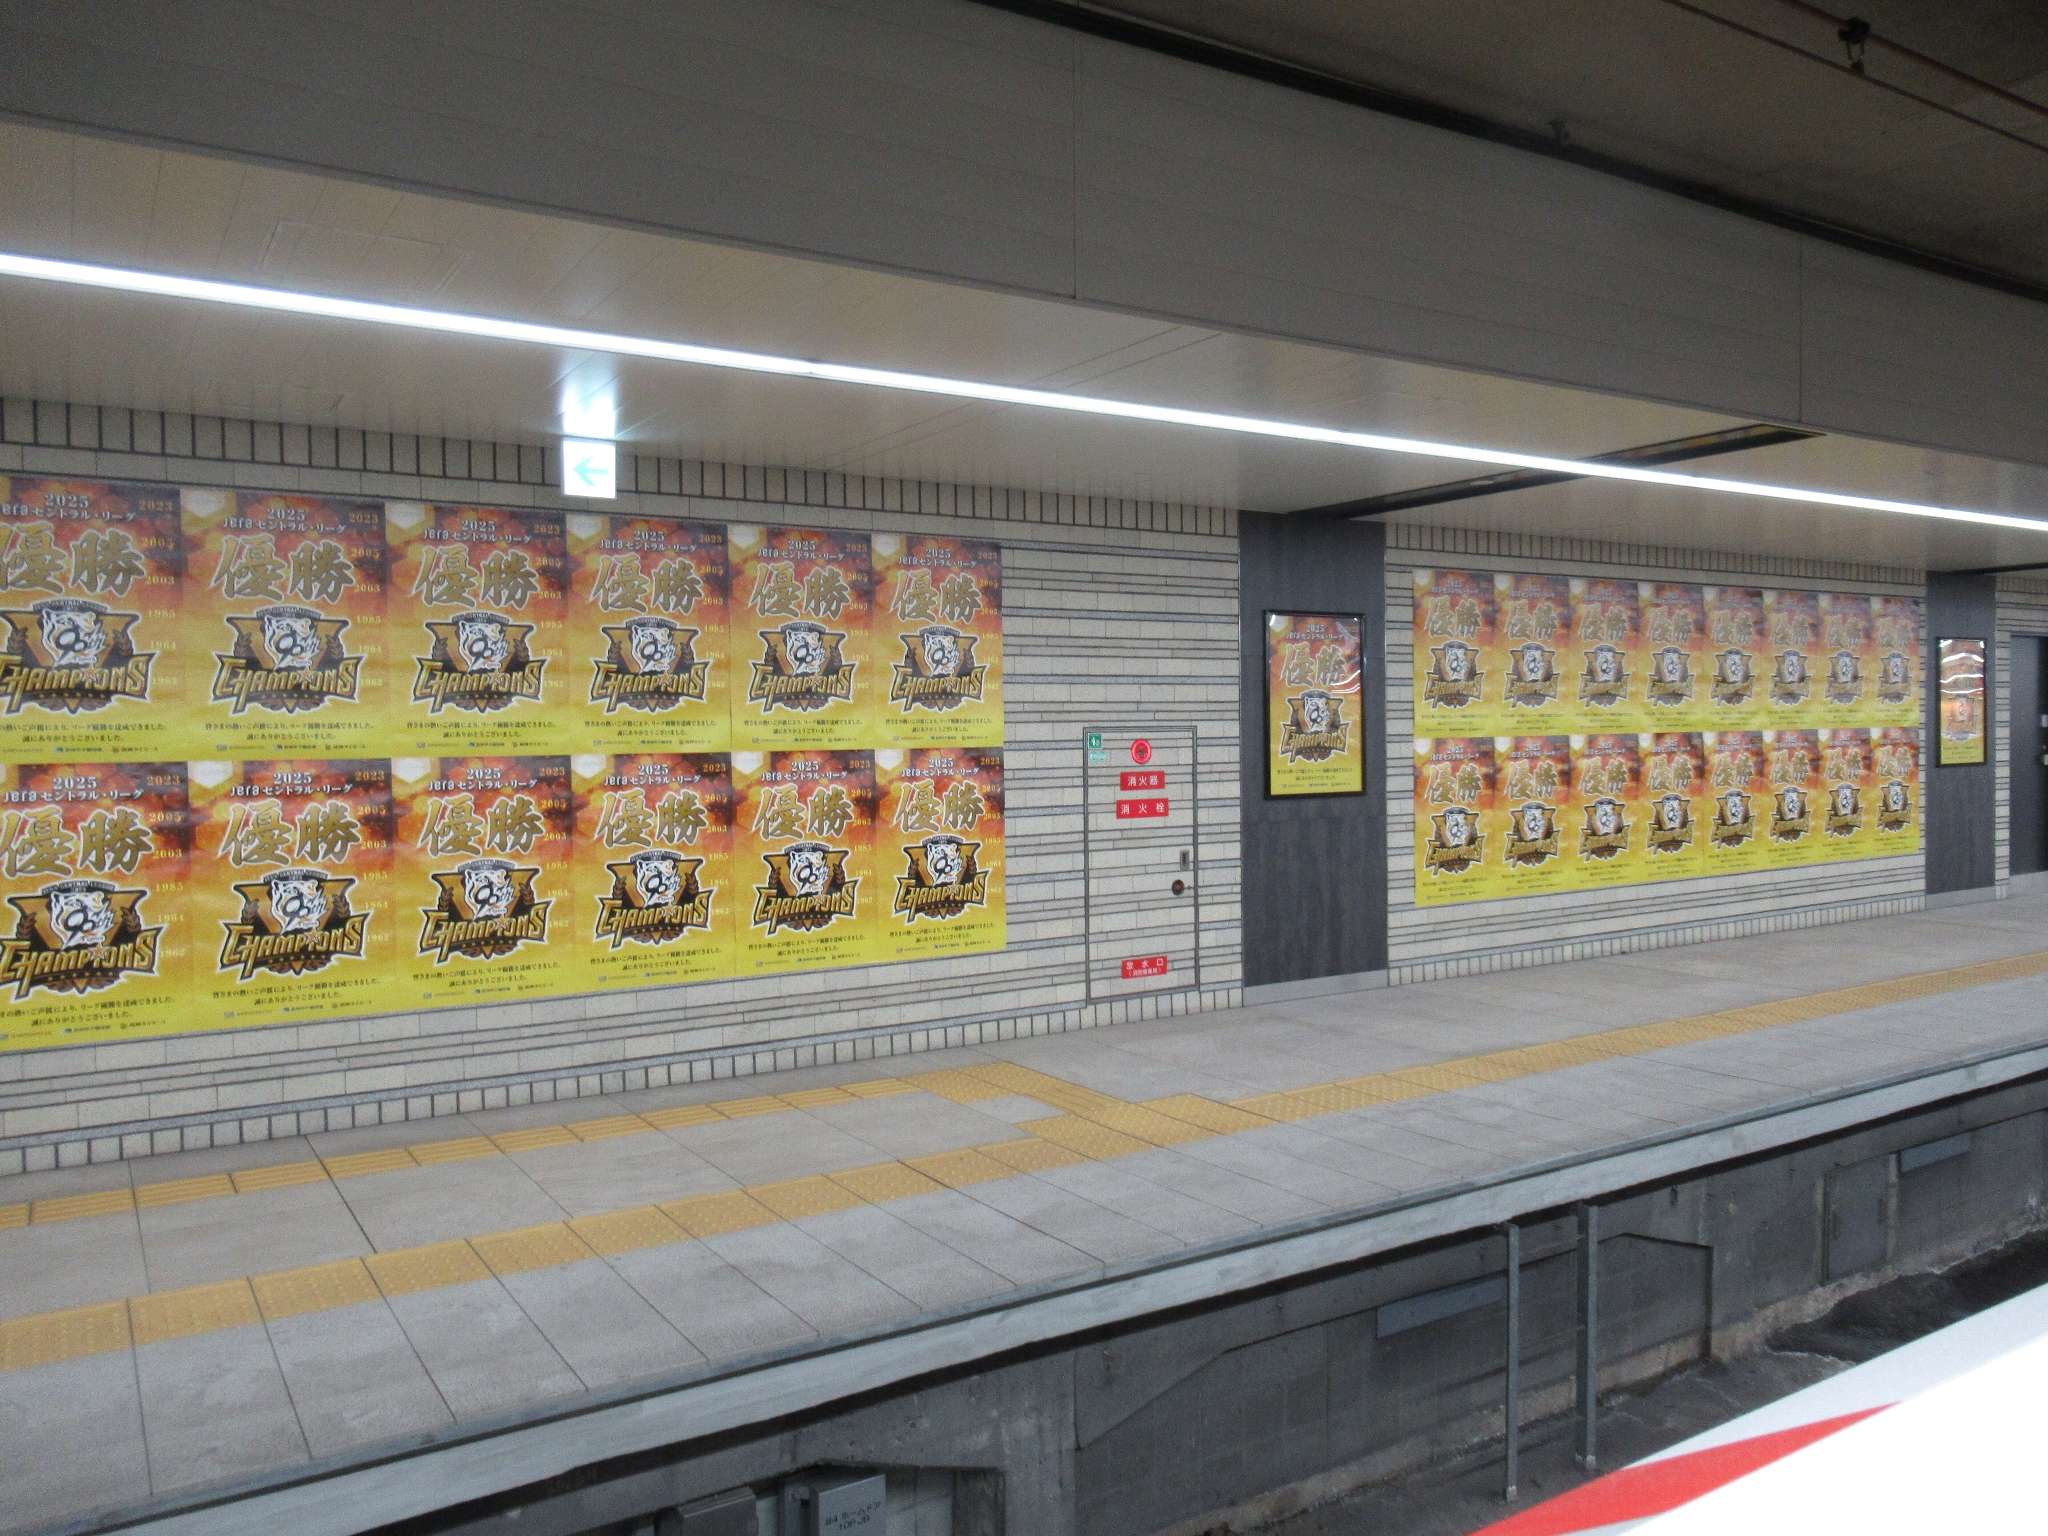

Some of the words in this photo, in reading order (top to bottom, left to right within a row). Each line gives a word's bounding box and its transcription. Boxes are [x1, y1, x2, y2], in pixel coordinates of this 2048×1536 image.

[44, 493, 89, 508] 2025
[266, 507, 305, 521] 2025
[461, 519, 495, 532] 2025
[634, 529, 664, 541] 2025
[788, 539, 815, 550] 2025
[0, 517, 145, 595] 優勝
[926, 547, 950, 558] 2025
[211, 530, 354, 602] 優勝
[412, 541, 539, 608] 優勝
[590, 550, 703, 613] 優勝
[749, 559, 849, 618] 優勝
[891, 566, 981, 622] 優勝
[0, 655, 146, 713] CHAMPIONS
[216, 658, 355, 712] CHAMPIONS
[416, 661, 539, 712] CHAMPIONS
[638, 764, 669, 774] 2025
[791, 761, 819, 770] 2025
[929, 758, 953, 767] 2025
[146, 775, 180, 786] 2023
[273, 772, 311, 784] 2025
[354, 771, 384, 781] 2023
[466, 768, 500, 779] 2025
[1128, 775, 1158, 786] 消火器
[53, 776, 97, 789] 2025
[40, 788, 144, 802] セントラル・リーグ
[752, 781, 853, 841] 優勝
[894, 777, 984, 833] 優勝
[1121, 802, 1166, 815] 消火栓
[149, 812, 181, 823] 2005
[417, 791, 544, 858] 優勝
[594, 786, 707, 849] 優勝
[218, 796, 361, 868] 優勝
[0, 802, 153, 879] 優勝
[152, 849, 182, 859] 2003
[423, 903, 545, 962] CHAMPIONS
[224, 915, 362, 979] CHAMPIONS
[0, 929, 154, 998] CHAMPIONS
